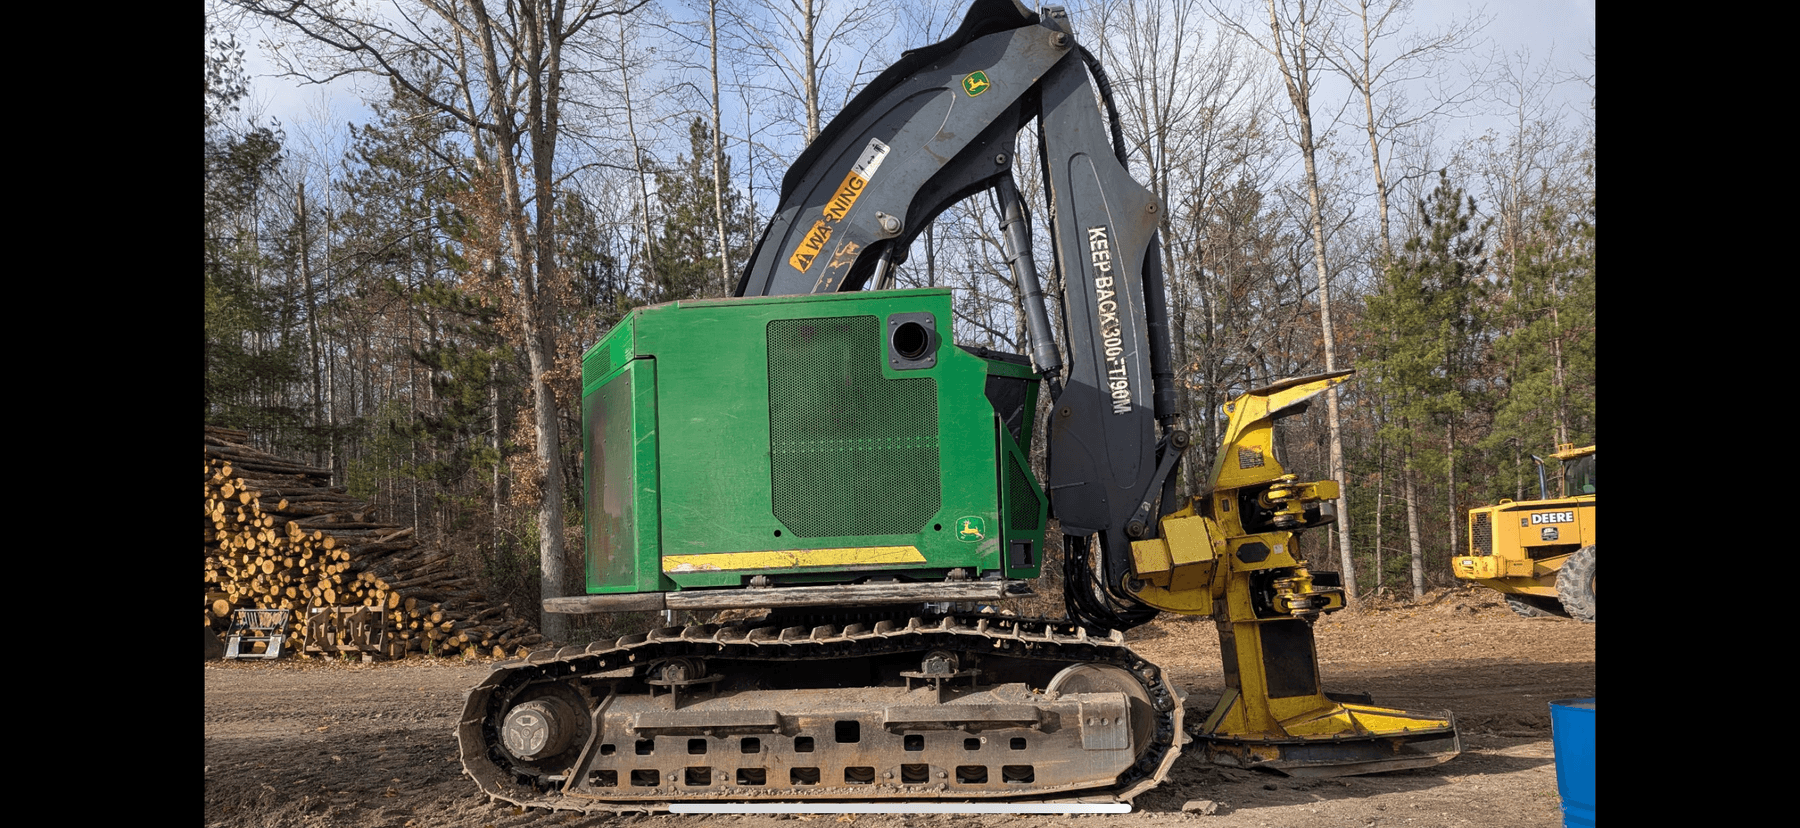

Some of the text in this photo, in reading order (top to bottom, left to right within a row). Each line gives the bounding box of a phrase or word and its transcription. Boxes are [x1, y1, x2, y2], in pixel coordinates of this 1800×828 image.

[806, 176, 864, 251] WARNING
[1088, 227, 1112, 272] KEEP
[1095, 276, 1119, 326] BACK
[1532, 511, 1574, 524] DEERE
